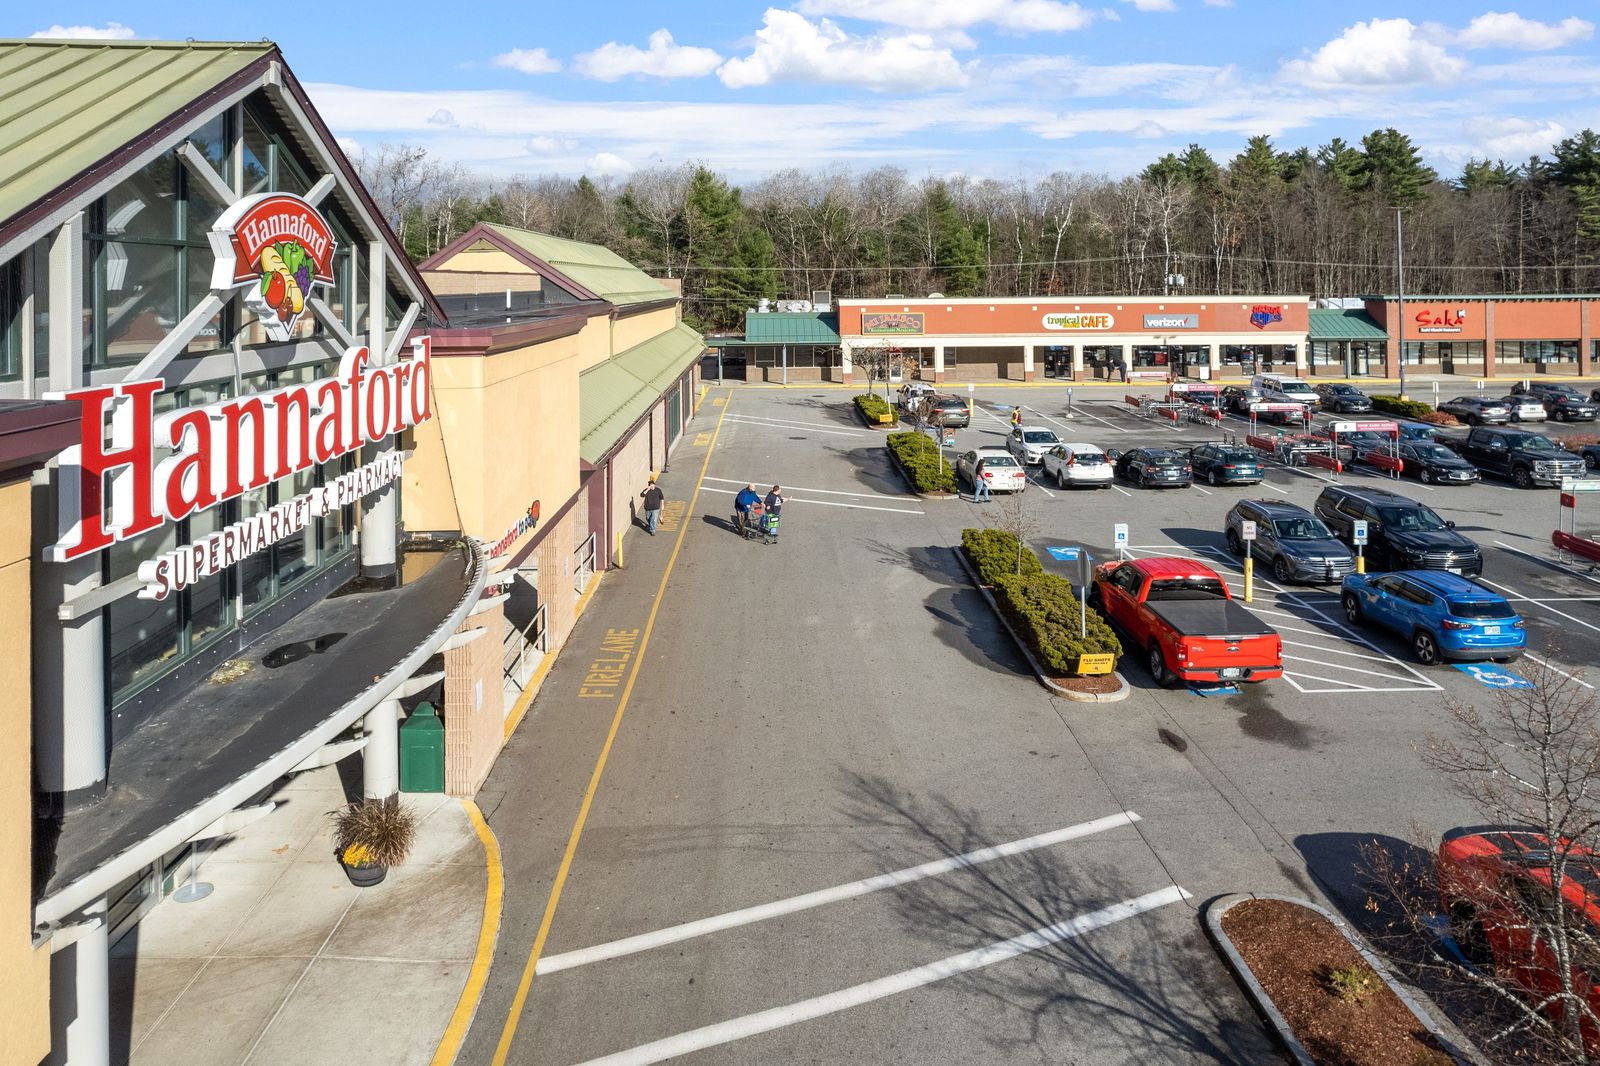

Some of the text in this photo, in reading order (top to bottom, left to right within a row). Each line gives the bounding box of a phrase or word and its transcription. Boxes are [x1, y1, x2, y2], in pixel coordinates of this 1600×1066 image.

[242, 213, 327, 260] Hannaford
[1047, 315, 1080, 326] tropical
[1080, 315, 1109, 328] CAFE
[1146, 317, 1184, 327] verizon
[65, 336, 431, 561] Hannaford
[154, 453, 404, 600] SUPERMARKET & PHARMACY
